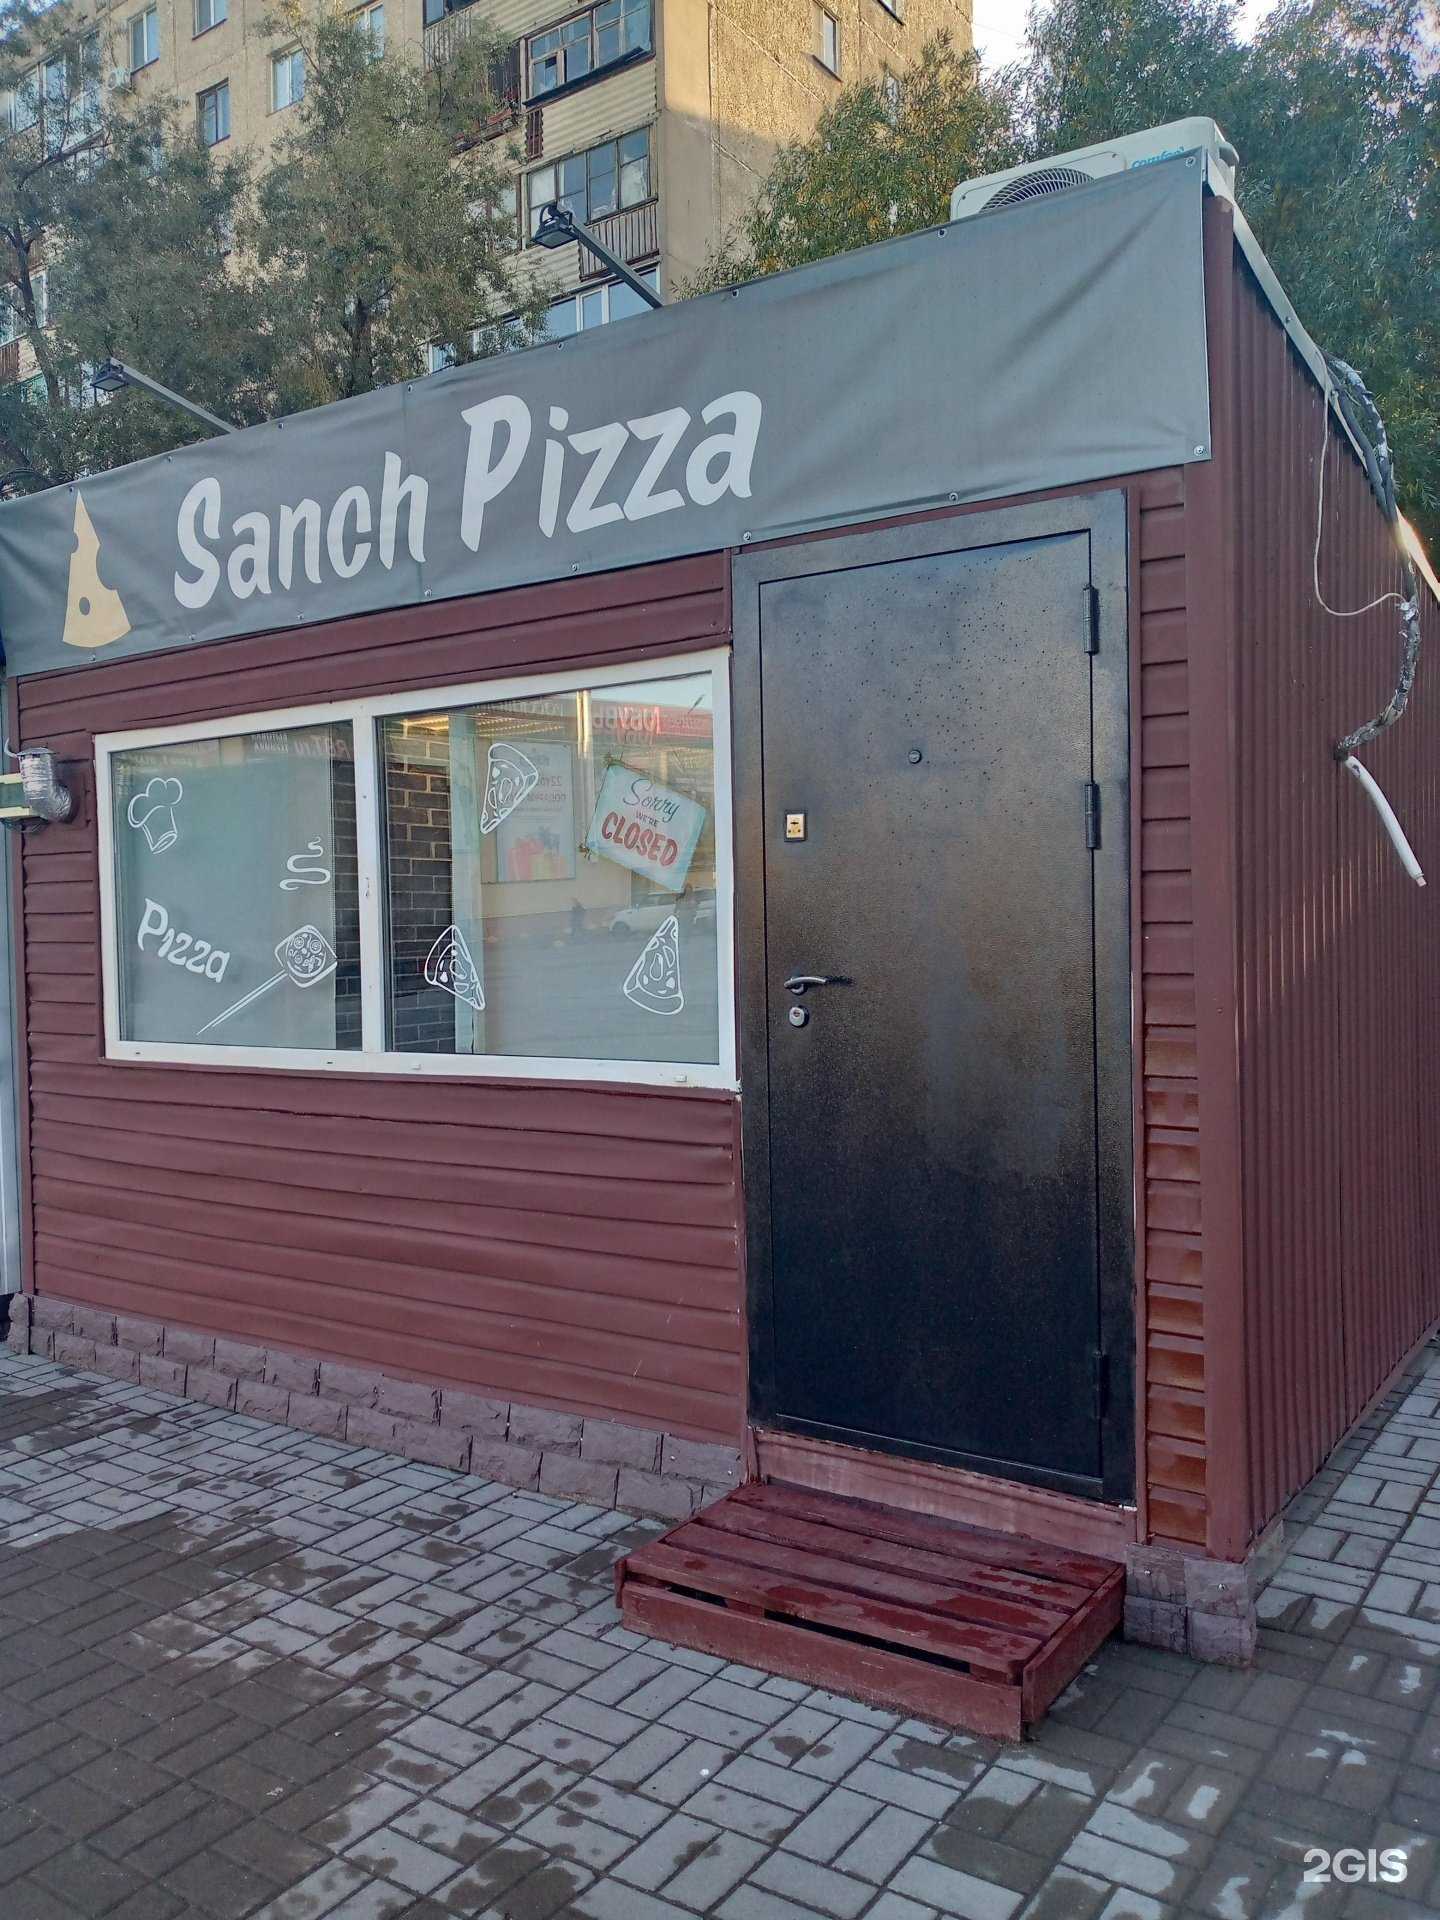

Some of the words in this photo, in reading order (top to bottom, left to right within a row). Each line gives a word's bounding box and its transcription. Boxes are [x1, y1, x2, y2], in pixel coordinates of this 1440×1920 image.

[174, 451, 429, 609] Sanch
[460, 391, 762, 552] Pizza
[622, 778, 681, 823] Sorry
[601, 811, 678, 867] CLOSED
[137, 898, 231, 984] Pizza
